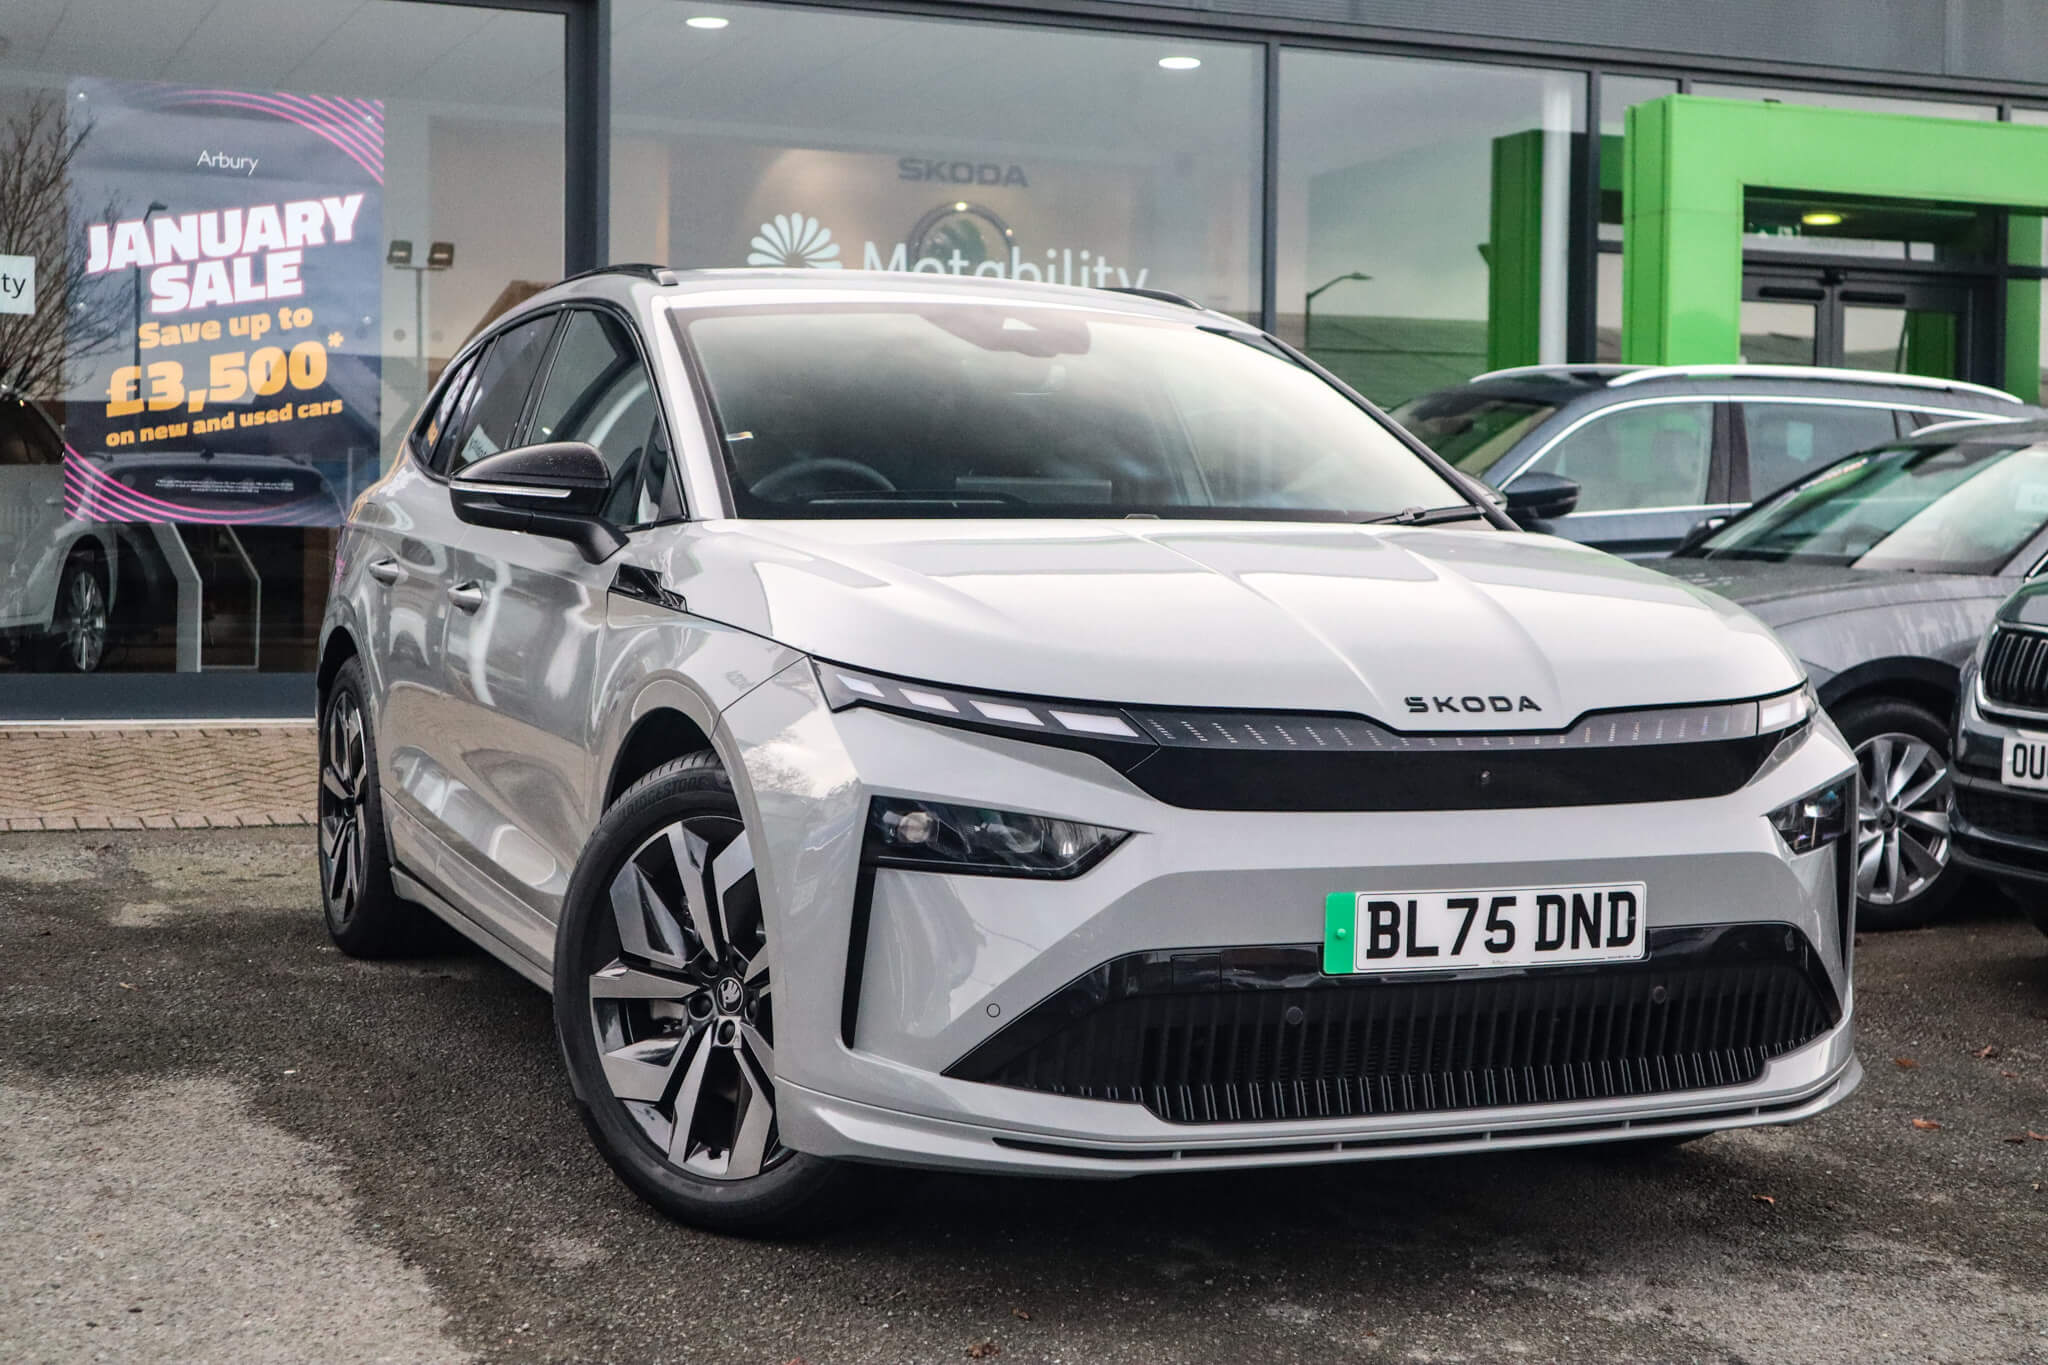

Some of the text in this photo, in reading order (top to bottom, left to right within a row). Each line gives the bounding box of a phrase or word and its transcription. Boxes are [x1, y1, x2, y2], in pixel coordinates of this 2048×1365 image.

[197, 150, 258, 175] Arbury
[898, 158, 1029, 188] SKODA
[87, 193, 364, 274] JANUARY
[150, 247, 303, 314] SALE
[139, 306, 313, 350] Save up to
[106, 398, 344, 448] on new and used cars
[1366, 890, 1637, 960] BL75 DND
